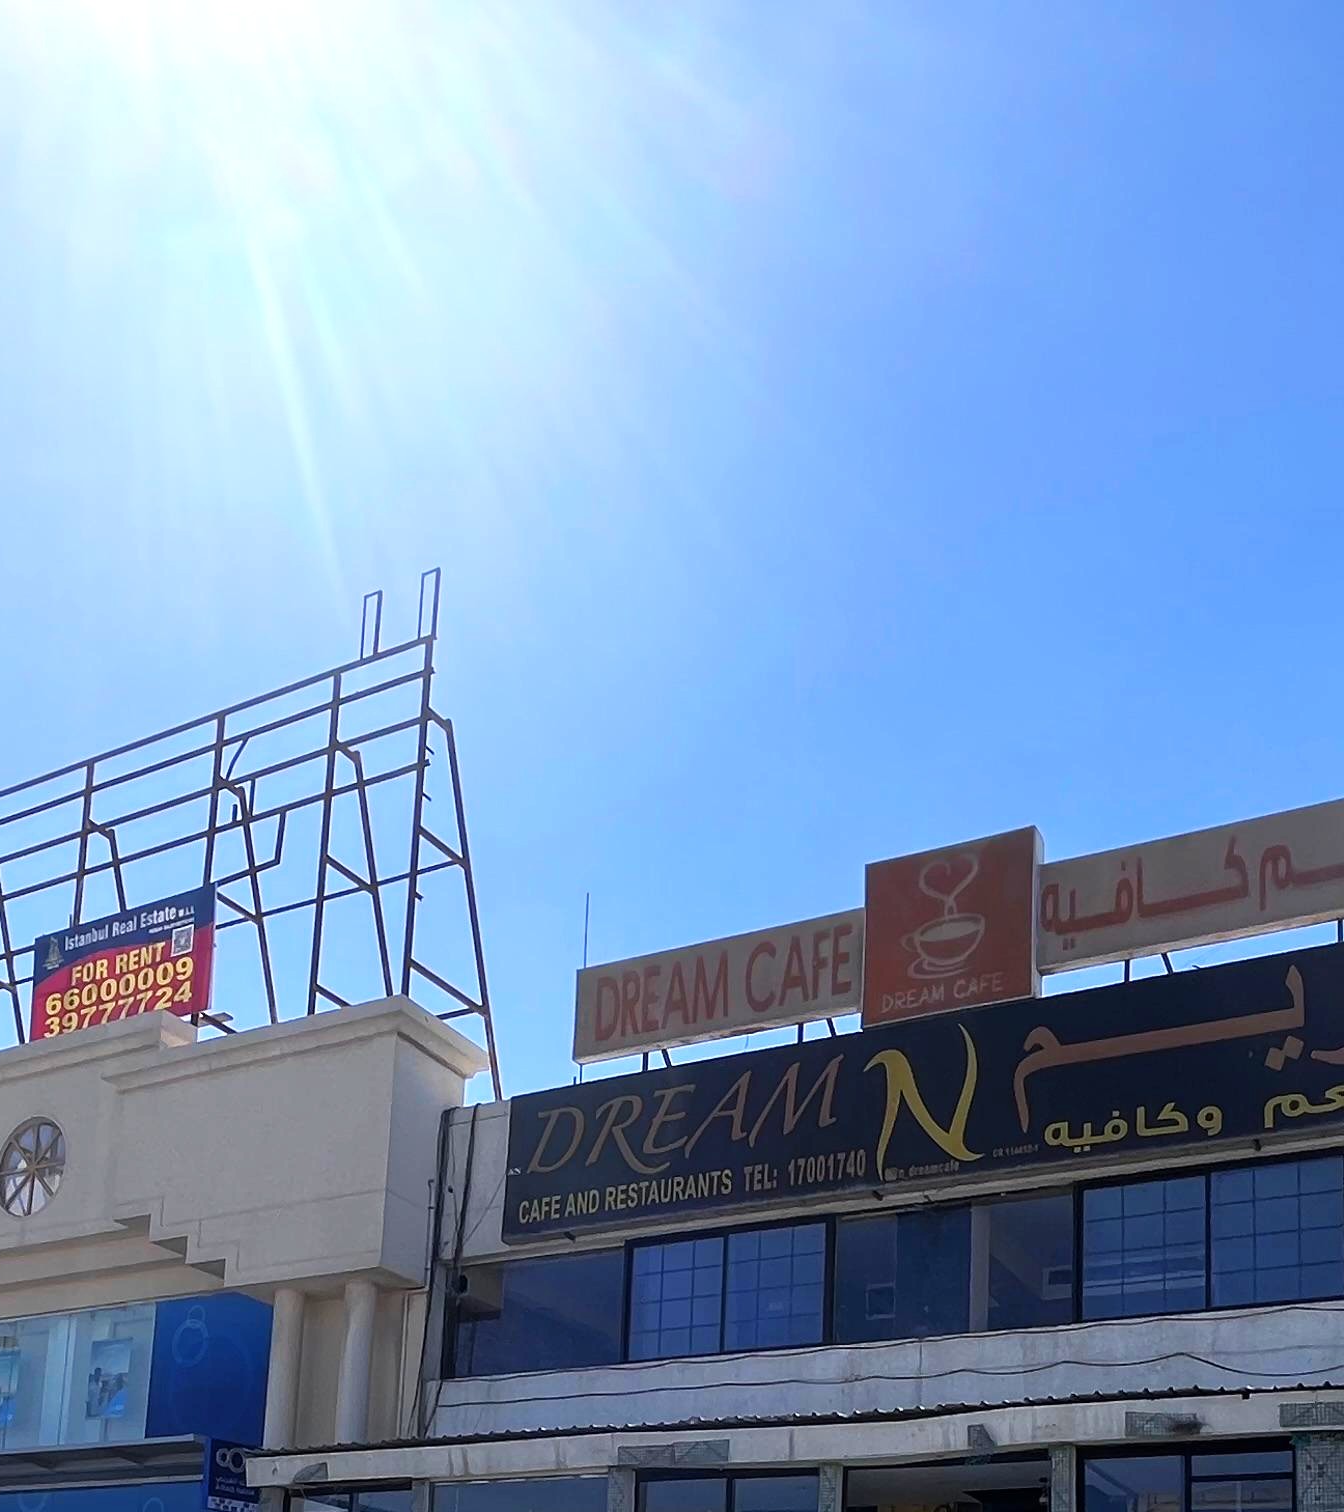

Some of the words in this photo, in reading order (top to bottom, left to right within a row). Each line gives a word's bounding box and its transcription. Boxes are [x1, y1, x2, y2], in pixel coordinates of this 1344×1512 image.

[1039, 836, 1249, 949] كافيه
[65, 924, 108, 951] Istanbul
[112, 918, 137, 938] Real
[140, 906, 176, 929] Estate
[45, 957, 194, 1016] 66000009
[71, 958, 108, 985] FOR
[115, 942, 166, 975] RENT
[593, 948, 729, 1041] DREAM
[745, 923, 854, 1013] CAFE
[880, 983, 945, 1013] DREAM
[952, 972, 1005, 999] CAFE
[44, 981, 192, 1038] 39777724
[527, 1053, 844, 1175] DREAM
[1044, 1102, 1224, 1153] وكافيه
[519, 1195, 561, 1223] CAFE
[565, 1189, 600, 1217] AND
[605, 1169, 732, 1211] RESTAURANTS
[743, 1164, 777, 1192] TEL:
[788, 1149, 866, 1187] 17001740
